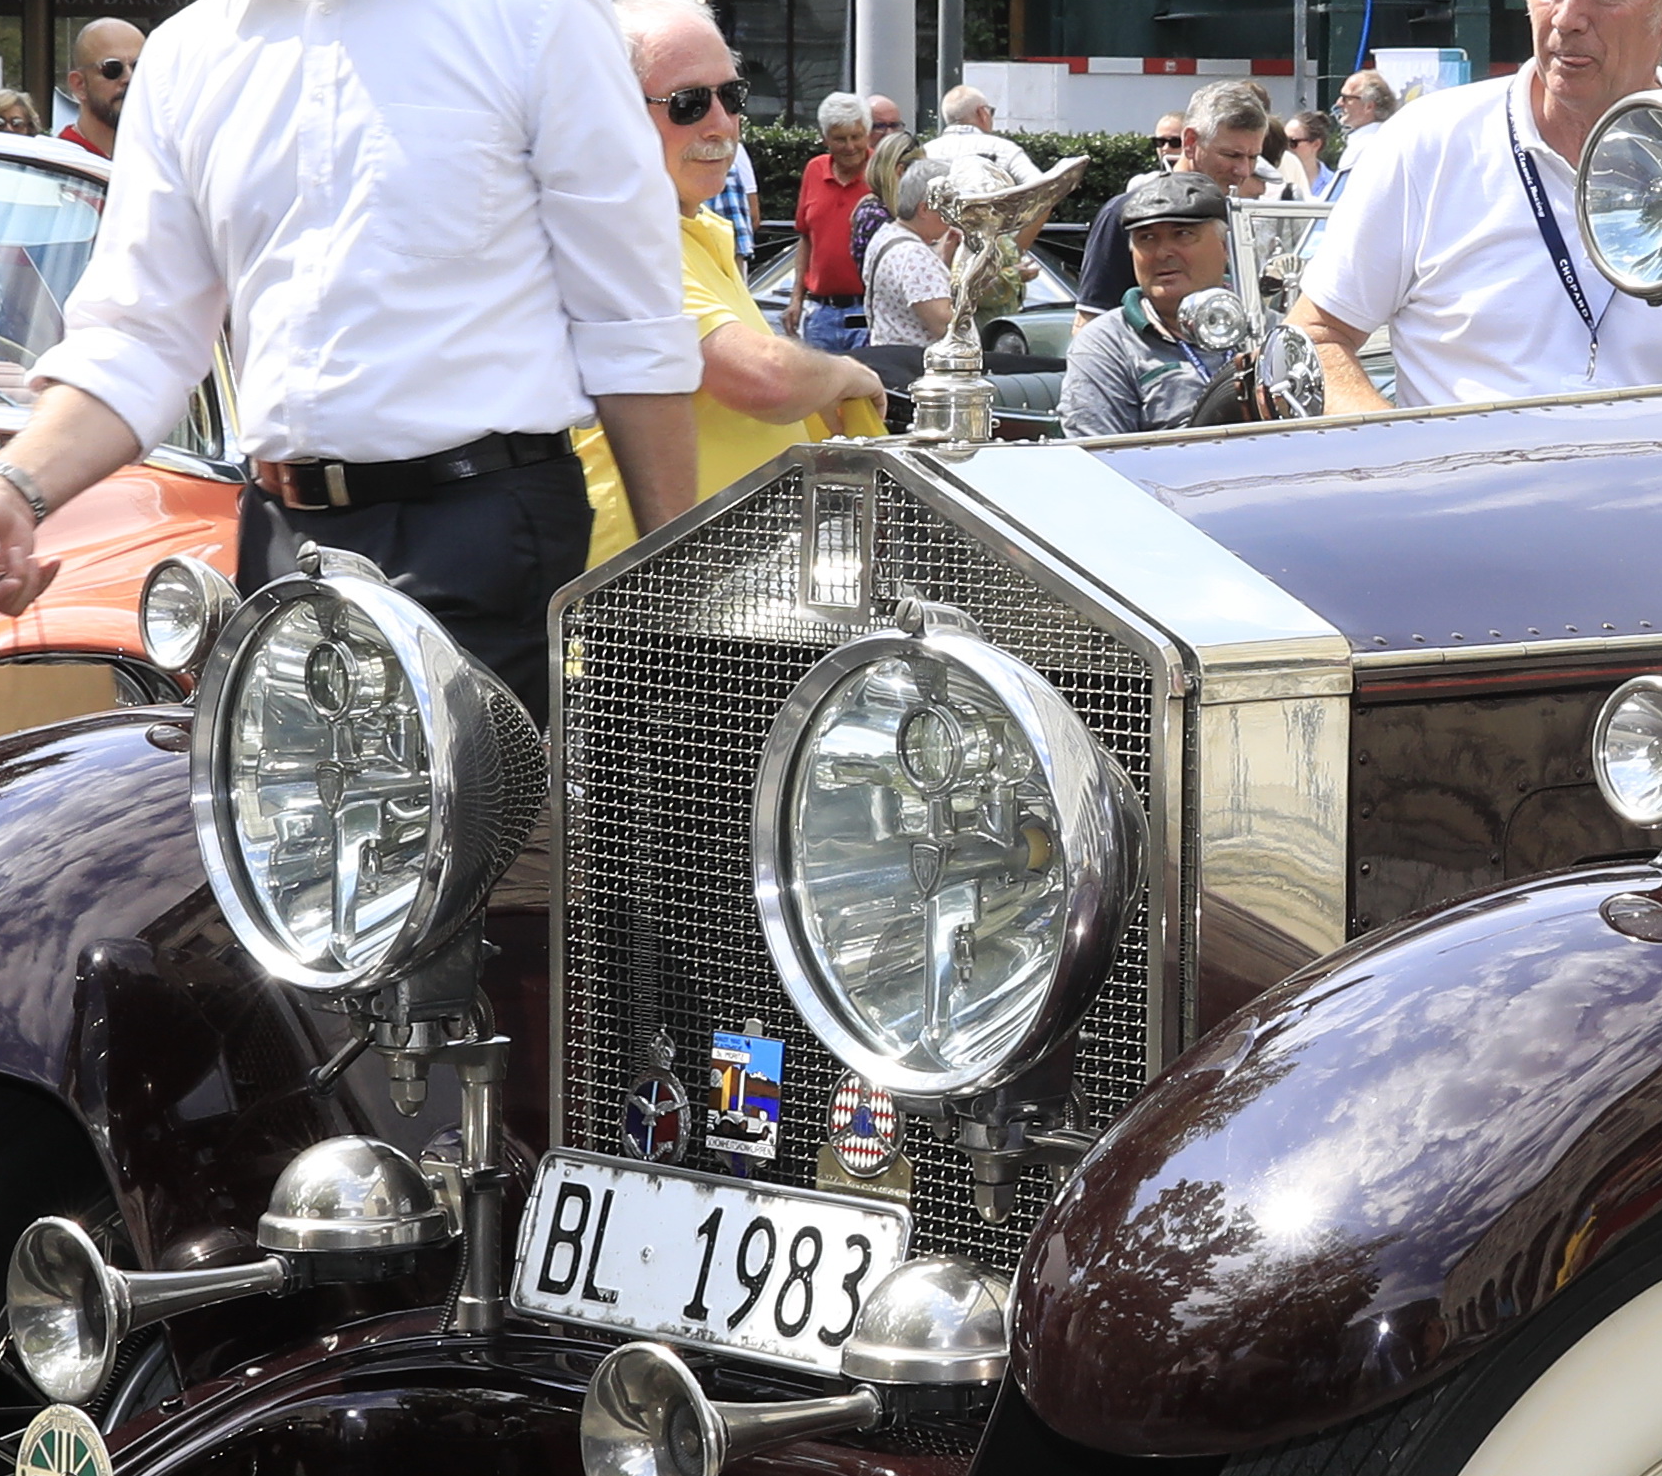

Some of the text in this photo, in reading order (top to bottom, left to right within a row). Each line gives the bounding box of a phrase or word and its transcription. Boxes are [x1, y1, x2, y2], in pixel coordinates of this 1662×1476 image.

[1559, 258, 1589, 318] CHOPARD
[535, 1180, 872, 1349] BL 1983
